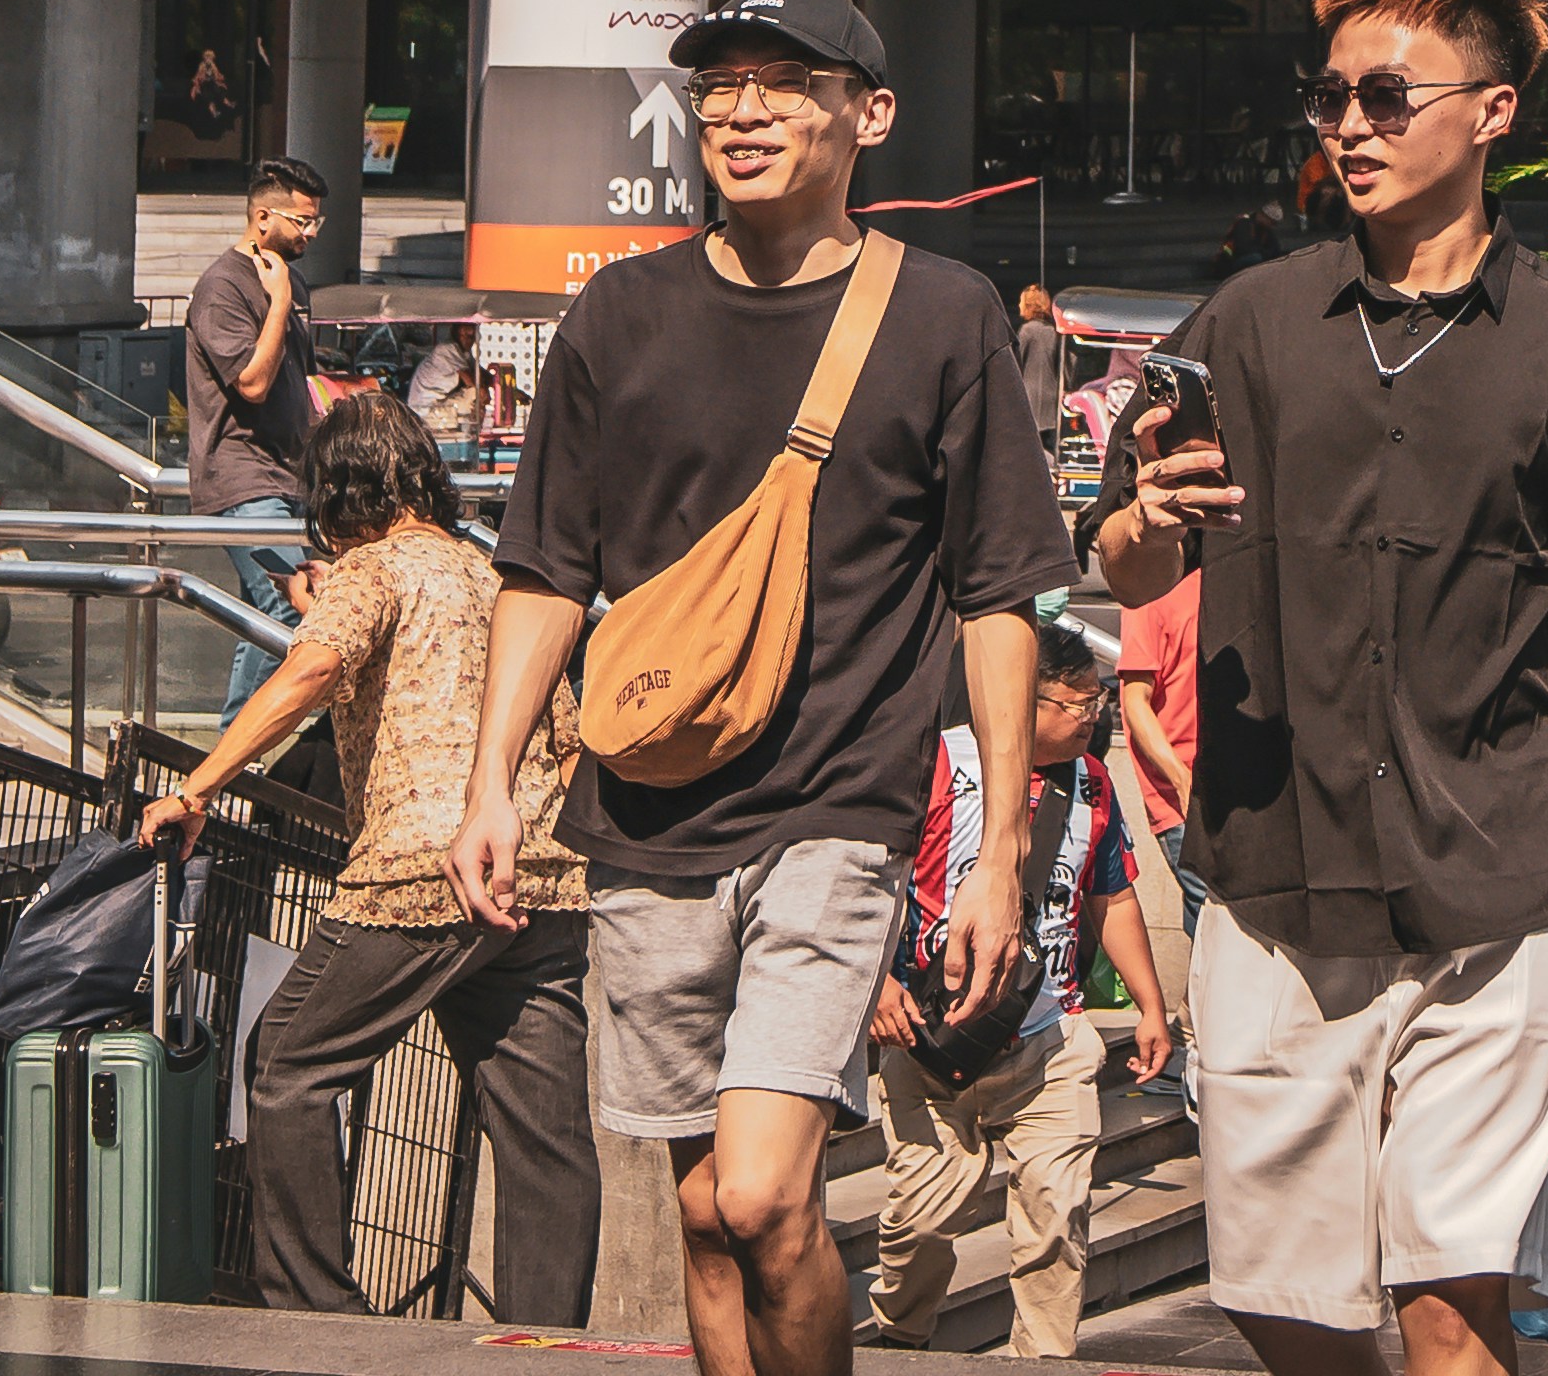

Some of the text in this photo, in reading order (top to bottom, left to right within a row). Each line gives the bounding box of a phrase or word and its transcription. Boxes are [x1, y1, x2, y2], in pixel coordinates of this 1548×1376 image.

[608, 11, 700, 30] mox
[607, 177, 694, 215] 30 M.
[616, 669, 671, 716] HERITAGE
